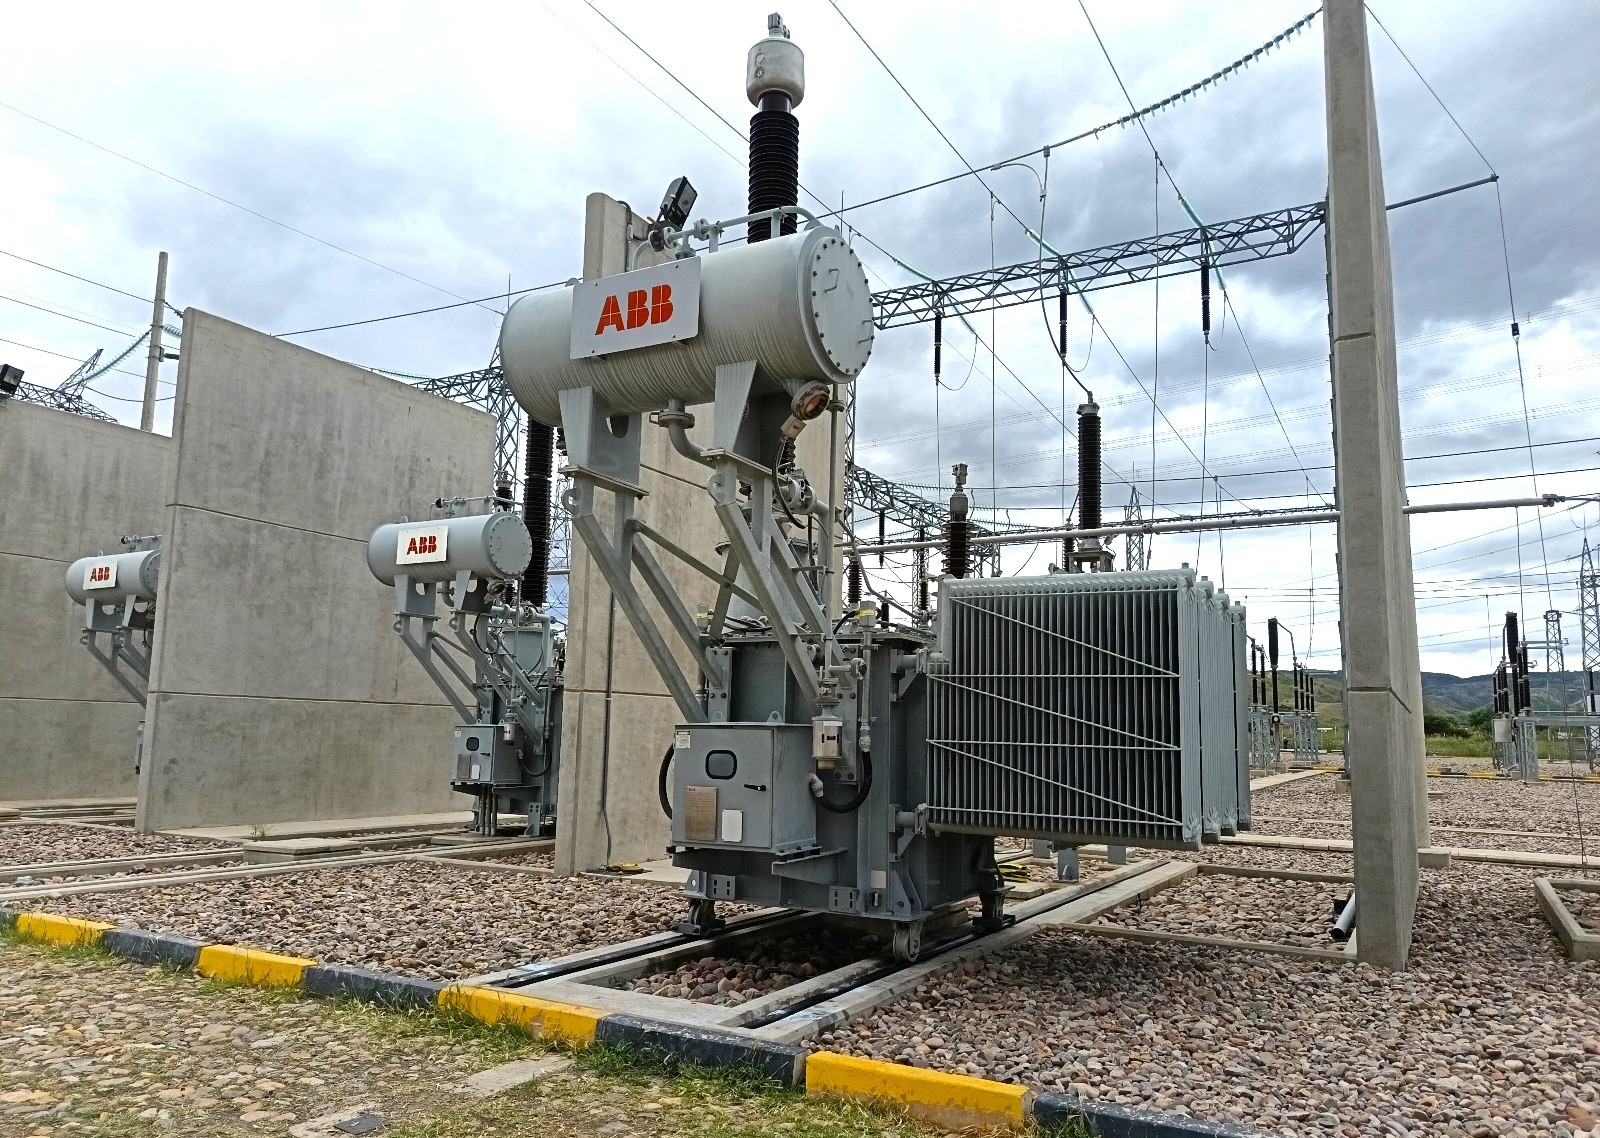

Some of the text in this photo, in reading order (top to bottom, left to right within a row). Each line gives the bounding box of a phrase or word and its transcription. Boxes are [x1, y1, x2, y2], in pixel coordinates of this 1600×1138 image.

[595, 284, 674, 335] ABB
[406, 535, 437, 555] ABB
[89, 566, 110, 582] ABB
